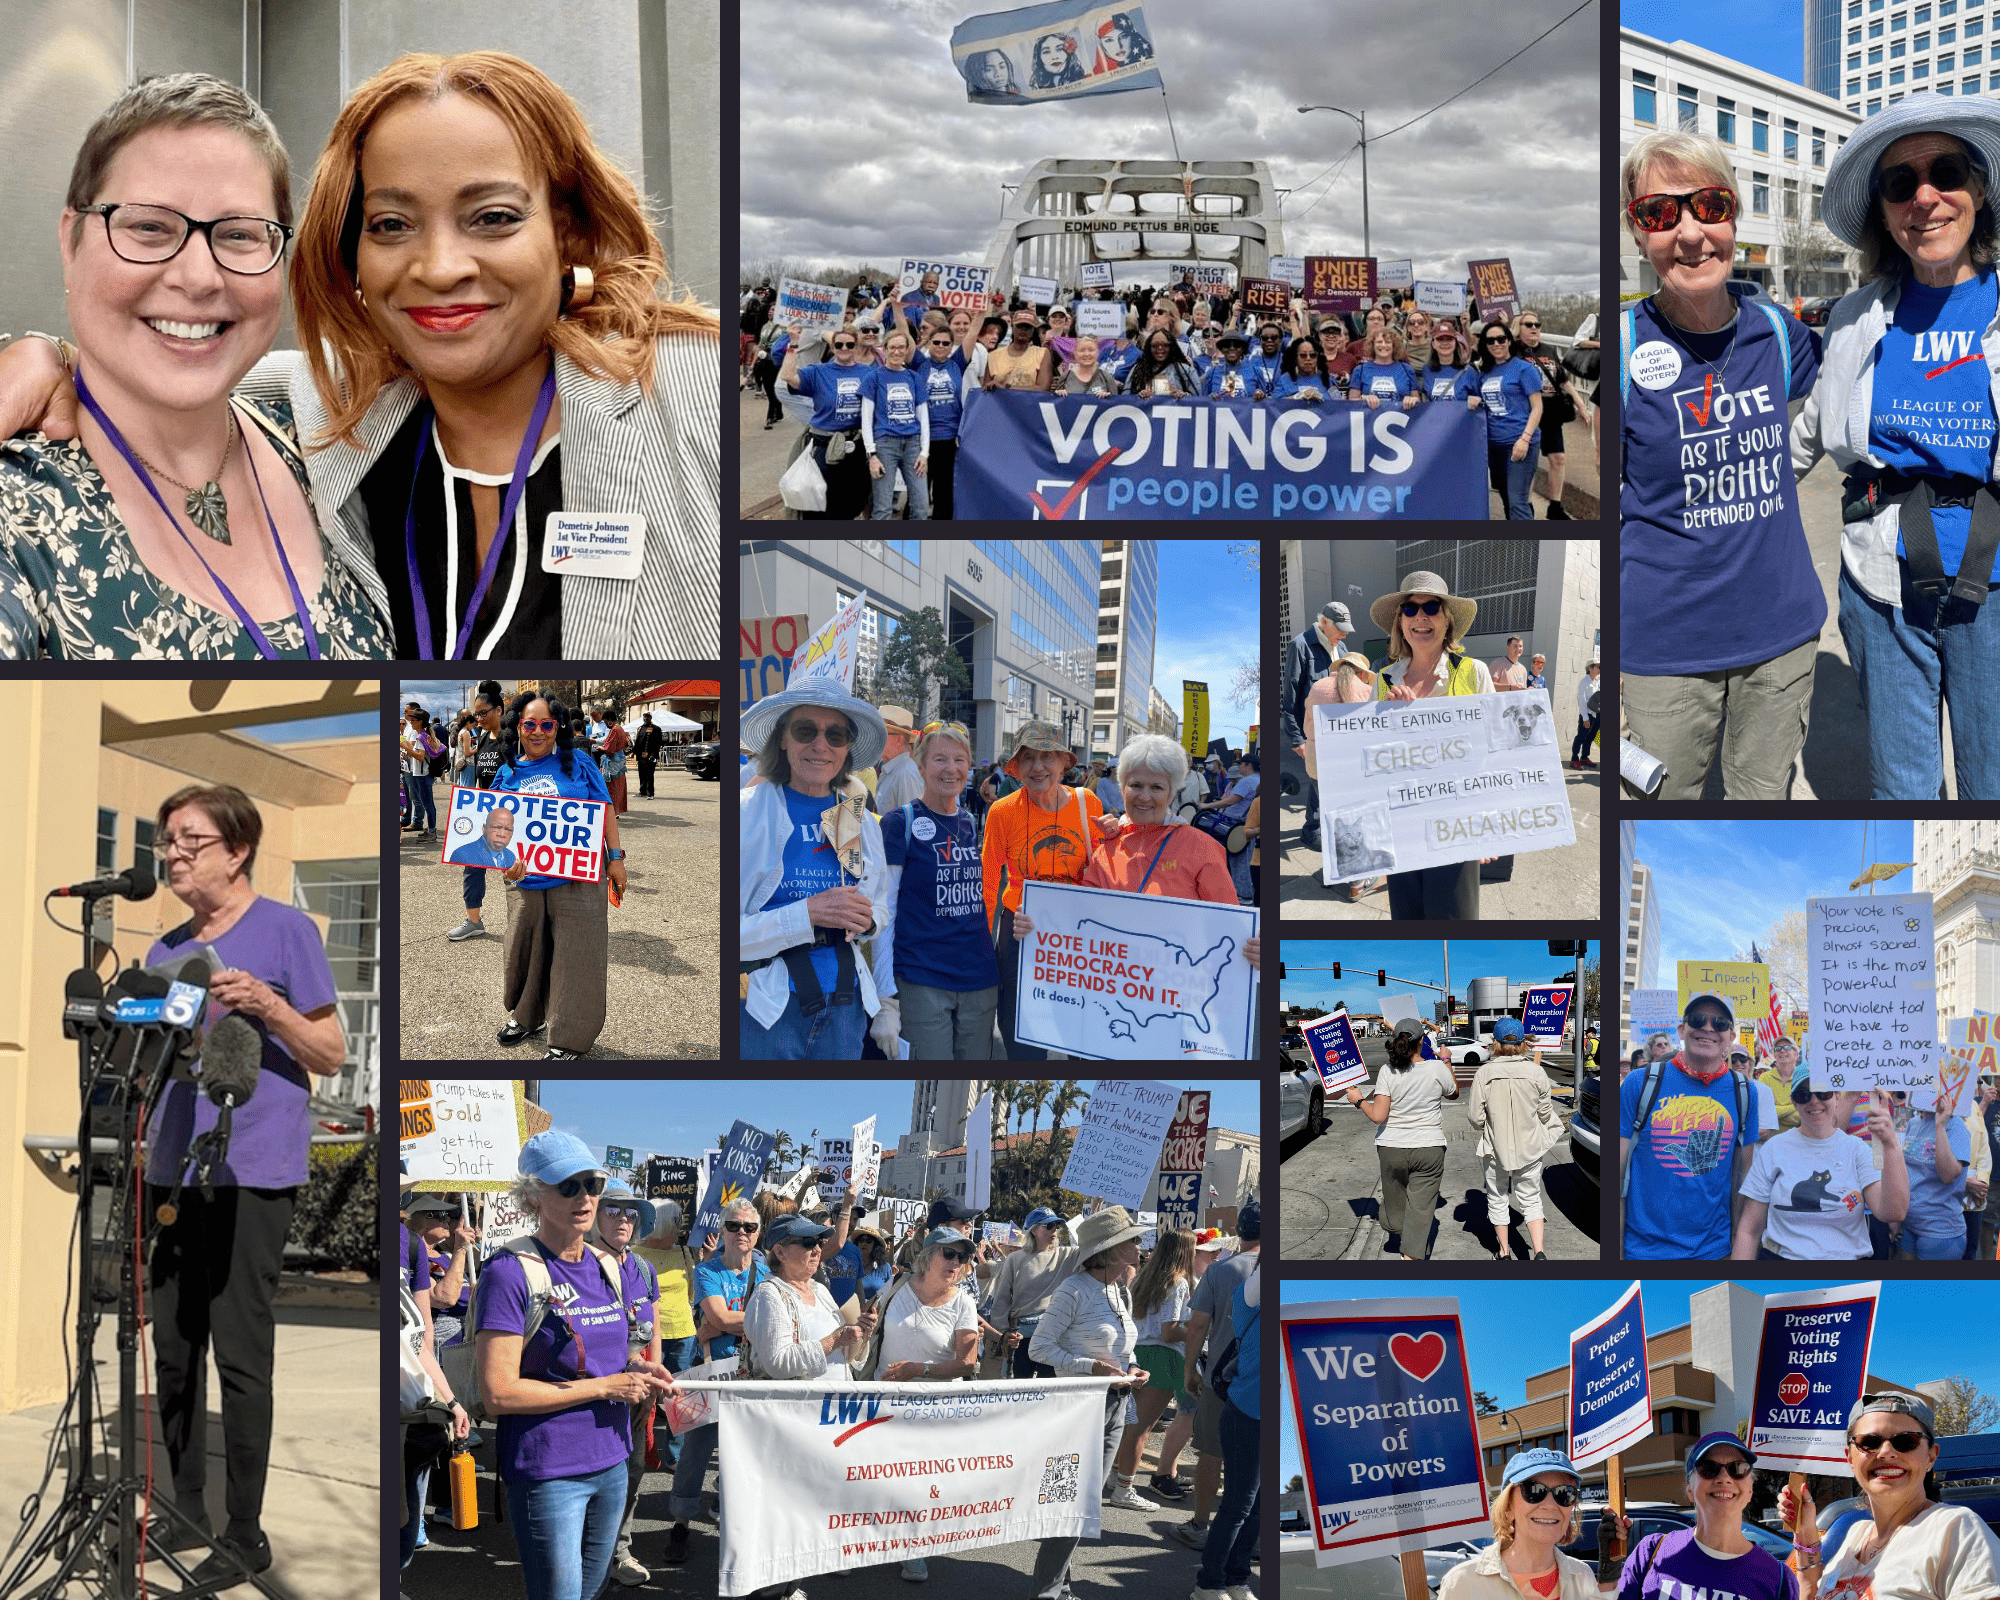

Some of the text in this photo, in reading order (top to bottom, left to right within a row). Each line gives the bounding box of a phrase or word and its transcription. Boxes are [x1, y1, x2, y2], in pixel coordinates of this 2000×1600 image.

[1064, 221, 1168, 232] EDMUND PETTUS
[904, 261, 989, 282] PROTECT
[1084, 265, 1106, 275] VOTE
[1314, 260, 1368, 276] UNITE
[1474, 263, 1509, 283] UNITE
[945, 279, 984, 293] OUR
[1251, 282, 1274, 291] UNITE
[1313, 275, 1368, 290] & RISE
[1490, 279, 1513, 295] RISE
[940, 290, 987, 309] VOTE!
[1247, 289, 1285, 308] RISE
[1327, 289, 1368, 297] Democracy
[1634, 347, 1673, 360] LEAGUE
[1911, 330, 1976, 362] LWV
[1639, 363, 1675, 375] WOMEN
[1649, 356, 1662, 365] OF
[1639, 370, 1678, 383] VOTERS
[1892, 399, 1984, 413] LEAGUE OF
[1874, 413, 1999, 431] WOMEN VOTERS
[1038, 402, 1414, 475] VOTING IS
[1681, 423, 1783, 470] AS IF YOUR
[1907, 430, 1991, 449] OAKLAND
[1107, 473, 1412, 518] people power
[1683, 502, 1755, 529] DEPENDED
[558, 520, 630, 532] Demetris Johnson
[558, 532, 628, 544] 1st Vice President
[551, 545, 570, 558] LWV
[967, 558, 983, 583] 505
[740, 615, 798, 658] NO
[1185, 683, 1204, 691] BAY
[1190, 692, 1199, 754] RESISTANCE
[1327, 708, 1482, 732] THEY'RE EATING THE
[1374, 738, 1467, 771] CHECKS
[1397, 770, 1546, 802] THEY'RE EATING THE
[456, 789, 601, 826] PROTECT
[1434, 805, 1559, 843] BALANCES
[525, 820, 591, 848] OUR
[516, 842, 598, 879] VOTE!
[795, 868, 834, 877] LEAGUE
[936, 867, 960, 882] AS IF
[780, 879, 819, 889] WOMEN
[935, 904, 971, 917] DEPENDED
[1853, 904, 1904, 917] vote is
[1823, 923, 1879, 938] precious,
[1036, 930, 1129, 959] VOTE LIKE
[1823, 938, 1921, 952] almost sacred.
[1035, 948, 1155, 982] DEMOCRACY
[1821, 957, 1890, 972] It is the
[1700, 967, 1760, 985] Impeach
[1034, 966, 1182, 1008] DEPENDS ON IT.
[1032, 986, 1086, 1010] (It does.)
[1531, 995, 1547, 1005] We
[166, 994, 195, 1025] 5
[1527, 1008, 1565, 1017] Separation
[1823, 1001, 1894, 1014] nonviolent
[1313, 1021, 1342, 1036] Preserve
[1540, 1017, 1548, 1025] of
[1850, 1017, 1909, 1033] have to
[1319, 1029, 1342, 1041] Voting
[1322, 1037, 1344, 1049] Rights
[1882, 1039, 1933, 1051] a more
[1326, 1058, 1357, 1074] SAVE Act
[1825, 1055, 1870, 1073] perfect
[1903, 1073, 1934, 1087] Lewis
[468, 1084, 506, 1101] takes the
[1658, 1093, 1685, 1109] THE
[436, 1099, 482, 1123] Gold
[1084, 1110, 1108, 1125] ANTI
[1123, 1107, 1164, 1129] NAZI
[740, 1128, 764, 1151] NO
[1173, 1125, 1199, 1137] THE
[440, 1134, 465, 1153] get
[468, 1130, 494, 1150] the
[1113, 1136, 1144, 1156] People
[723, 1146, 762, 1178] KINGS
[1162, 1136, 1206, 1171] PEOPLE
[442, 1152, 495, 1175] Shaft
[655, 1158, 686, 1167] WANT TO
[1097, 1160, 1140, 1180] American
[1104, 1149, 1149, 1178] Democracy
[1092, 1170, 1122, 1186] Choice
[651, 1184, 694, 1196] ORANGE
[1159, 1174, 1198, 1201] WE
[1164, 1202, 1189, 1212] THE
[699, 1211, 711, 1227] IN
[581, 1316, 604, 1326] OF SAN
[1784, 1310, 1852, 1328] Preserve
[1589, 1321, 1630, 1361] Protest
[1790, 1329, 1841, 1347] Voting
[1302, 1346, 1377, 1381] We
[1604, 1352, 1617, 1368] to
[1787, 1349, 1838, 1368] Rights
[1586, 1356, 1635, 1397] Preserve
[1579, 1369, 1642, 1417] Democracy
[1780, 1381, 1832, 1394] STOP the
[819, 1391, 1002, 1426] LWV LEAGUE WOMEN
[903, 1406, 982, 1420] OF SAN DIEGO
[1312, 1393, 1460, 1429] Separation
[1768, 1408, 1843, 1425] SAVE Act
[1381, 1428, 1409, 1452] of
[1574, 1436, 1590, 1450] LWV
[1752, 1433, 1770, 1443] LWV
[845, 1454, 1014, 1482] EMPOWERING VOTERS
[1348, 1456, 1446, 1485] Powers
[929, 1485, 941, 1500] &
[827, 1497, 1015, 1530] DEFENDING DEMOCRACY
[1321, 1502, 1413, 1529] LWV LEAGUE WOMEN
[1371, 1511, 1393, 1520] NORTH
[841, 1524, 1002, 1557] WWW.LWVSANDIEGO.ORG
